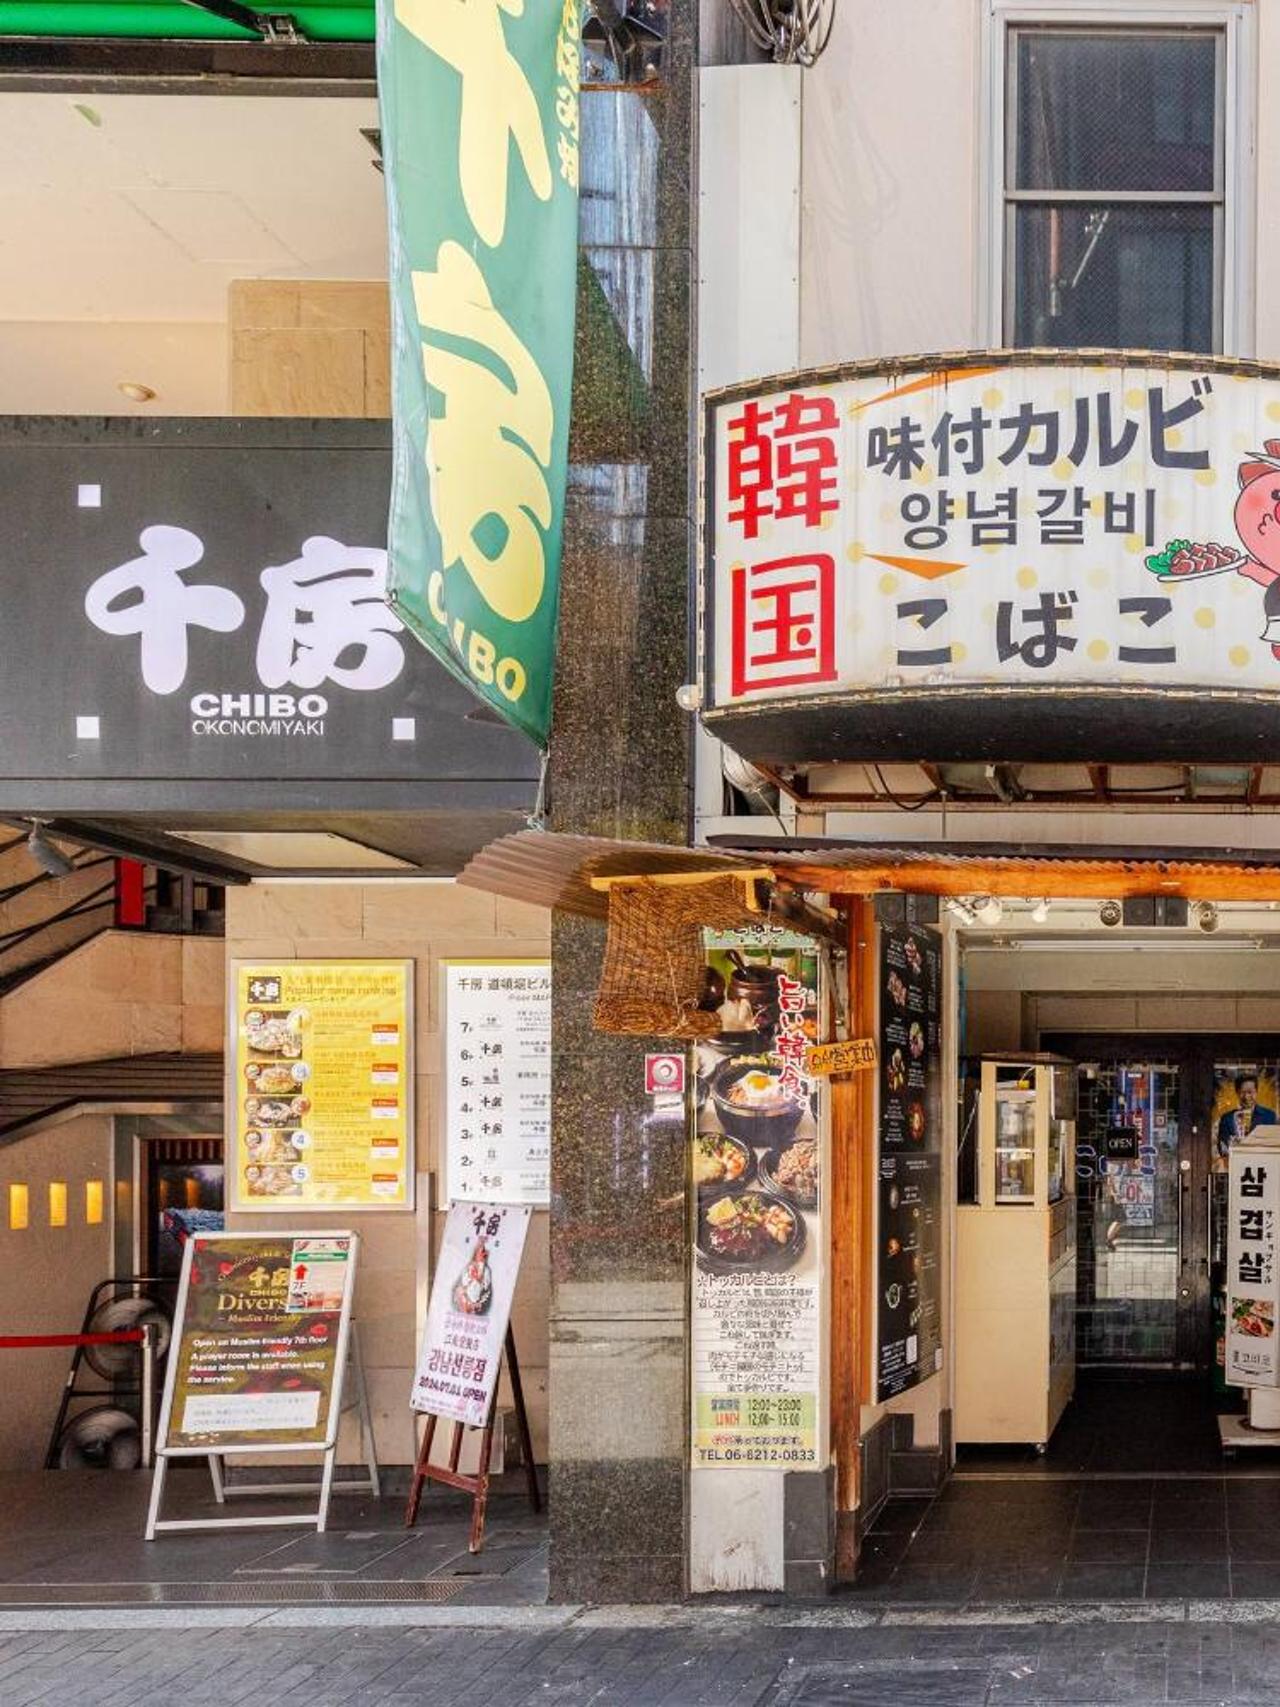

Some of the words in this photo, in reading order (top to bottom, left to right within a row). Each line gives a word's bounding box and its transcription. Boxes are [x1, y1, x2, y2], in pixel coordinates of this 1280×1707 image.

[866, 376, 1212, 481] 味付カルビ
[727, 391, 842, 698] 韓国
[901, 487, 1156, 550] 양념갈비
[84, 525, 406, 696] 千房
[896, 590, 1177, 669] こばこ
[190, 693, 329, 718] CHIBO
[191, 719, 325, 736] OKONOMIYAKI
[473, 1210, 501, 1236] 千房
[217, 1293, 288, 1311] Divers
